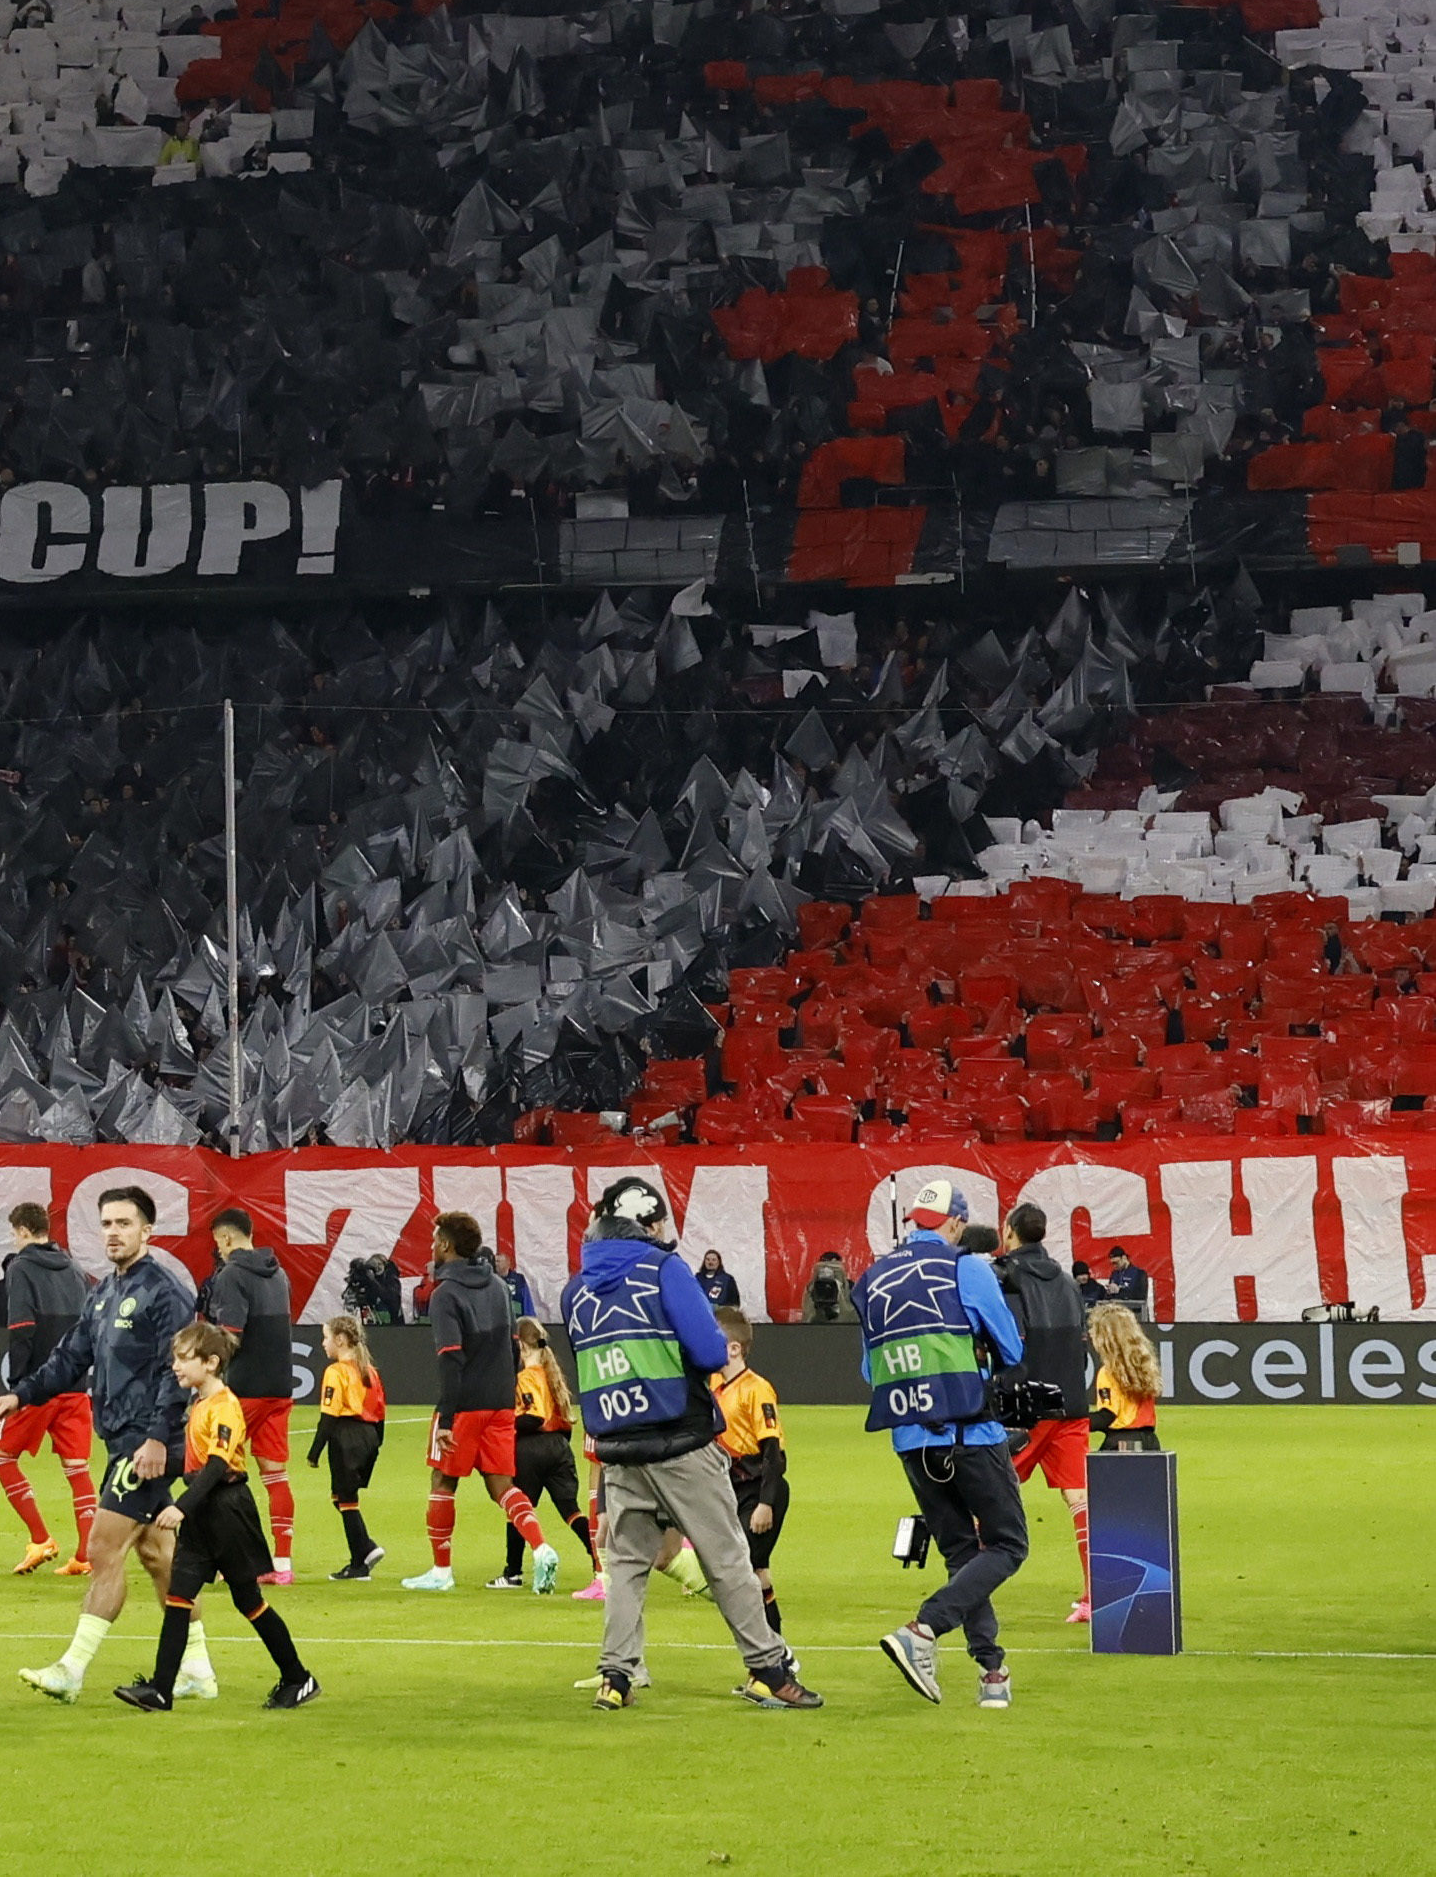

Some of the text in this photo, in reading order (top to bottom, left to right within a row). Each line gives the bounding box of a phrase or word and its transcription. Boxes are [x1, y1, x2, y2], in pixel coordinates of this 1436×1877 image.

[594, 1347, 631, 1381] HB
[883, 1342, 923, 1376] HB
[598, 1384, 650, 1422] 003
[888, 1382, 934, 1417] 045
[113, 1456, 144, 1493] 10
